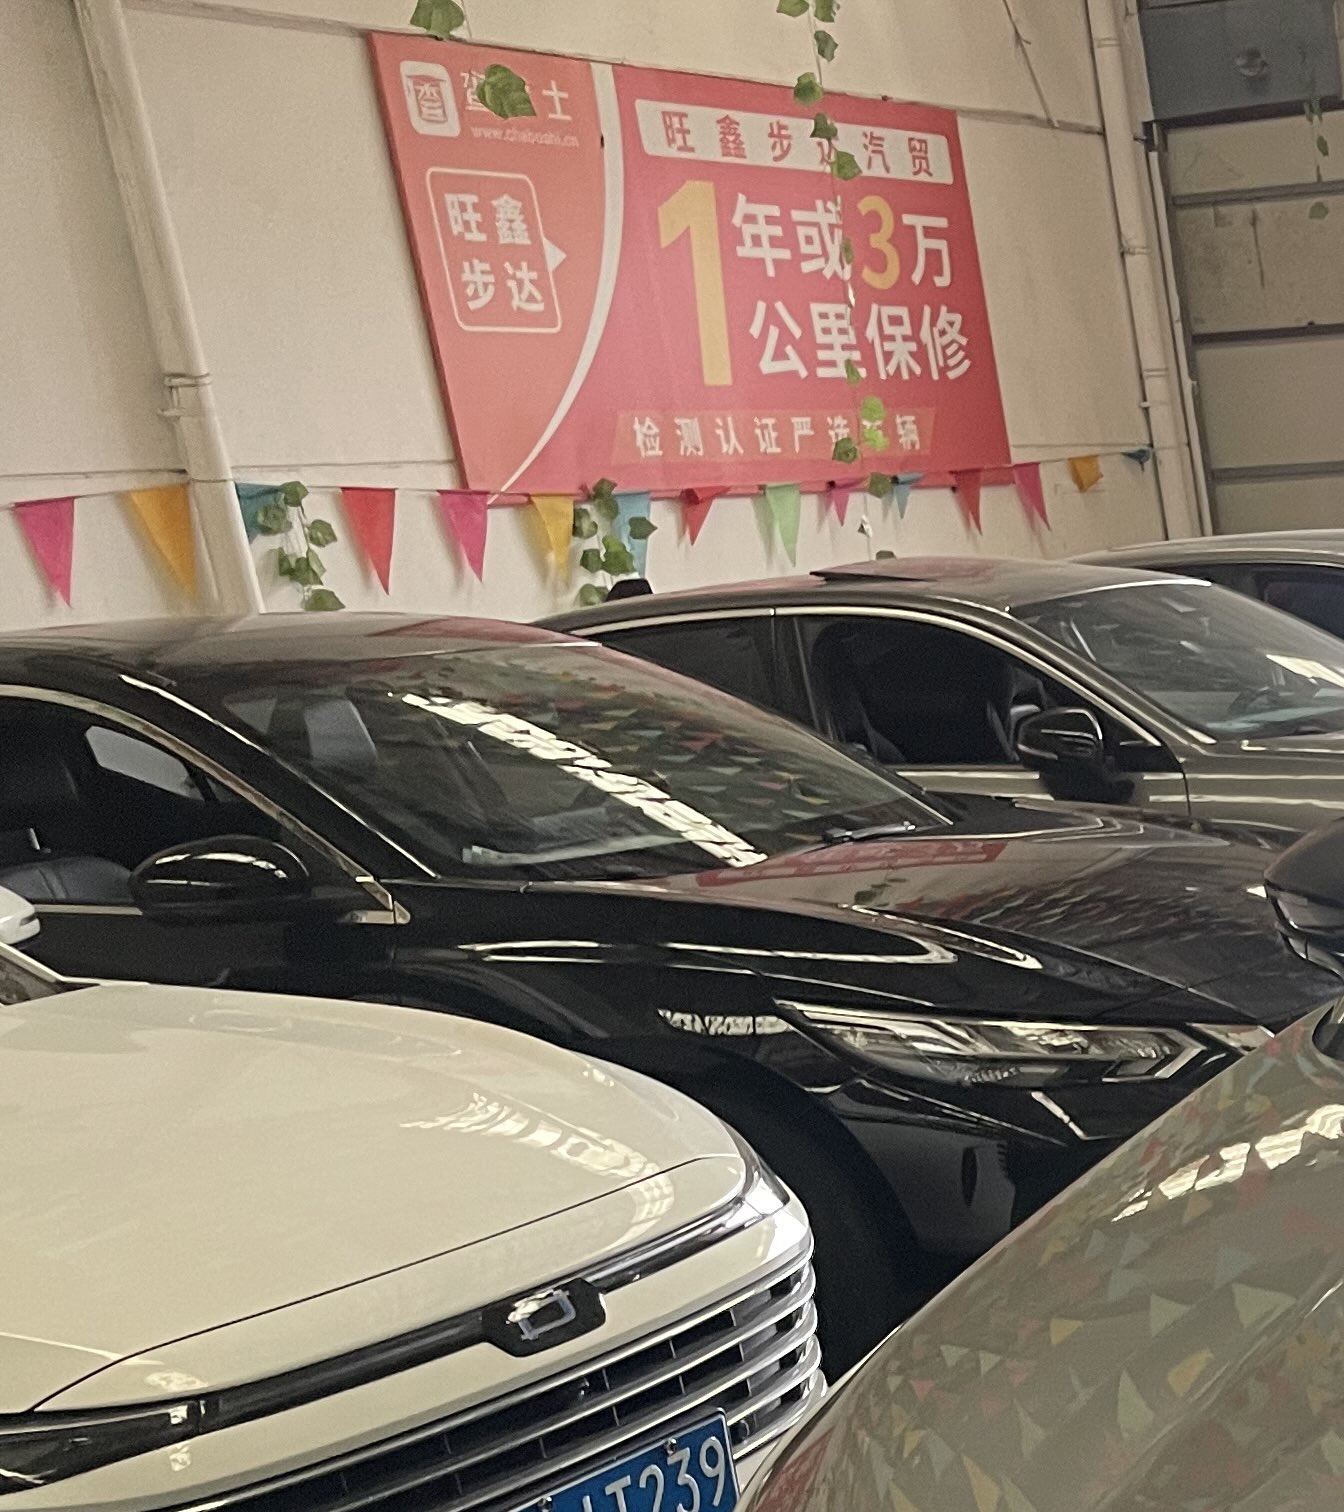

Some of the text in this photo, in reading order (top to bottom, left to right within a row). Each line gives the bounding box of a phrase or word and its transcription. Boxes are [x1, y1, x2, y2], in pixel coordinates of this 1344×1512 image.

[444, 193, 532, 245] 旺鑫
[461, 258, 545, 312] 步达
[657, 180, 733, 386] 1
[749, 300, 972, 380] 公里保修
[633, 406, 921, 457] 检测认证严选辆
